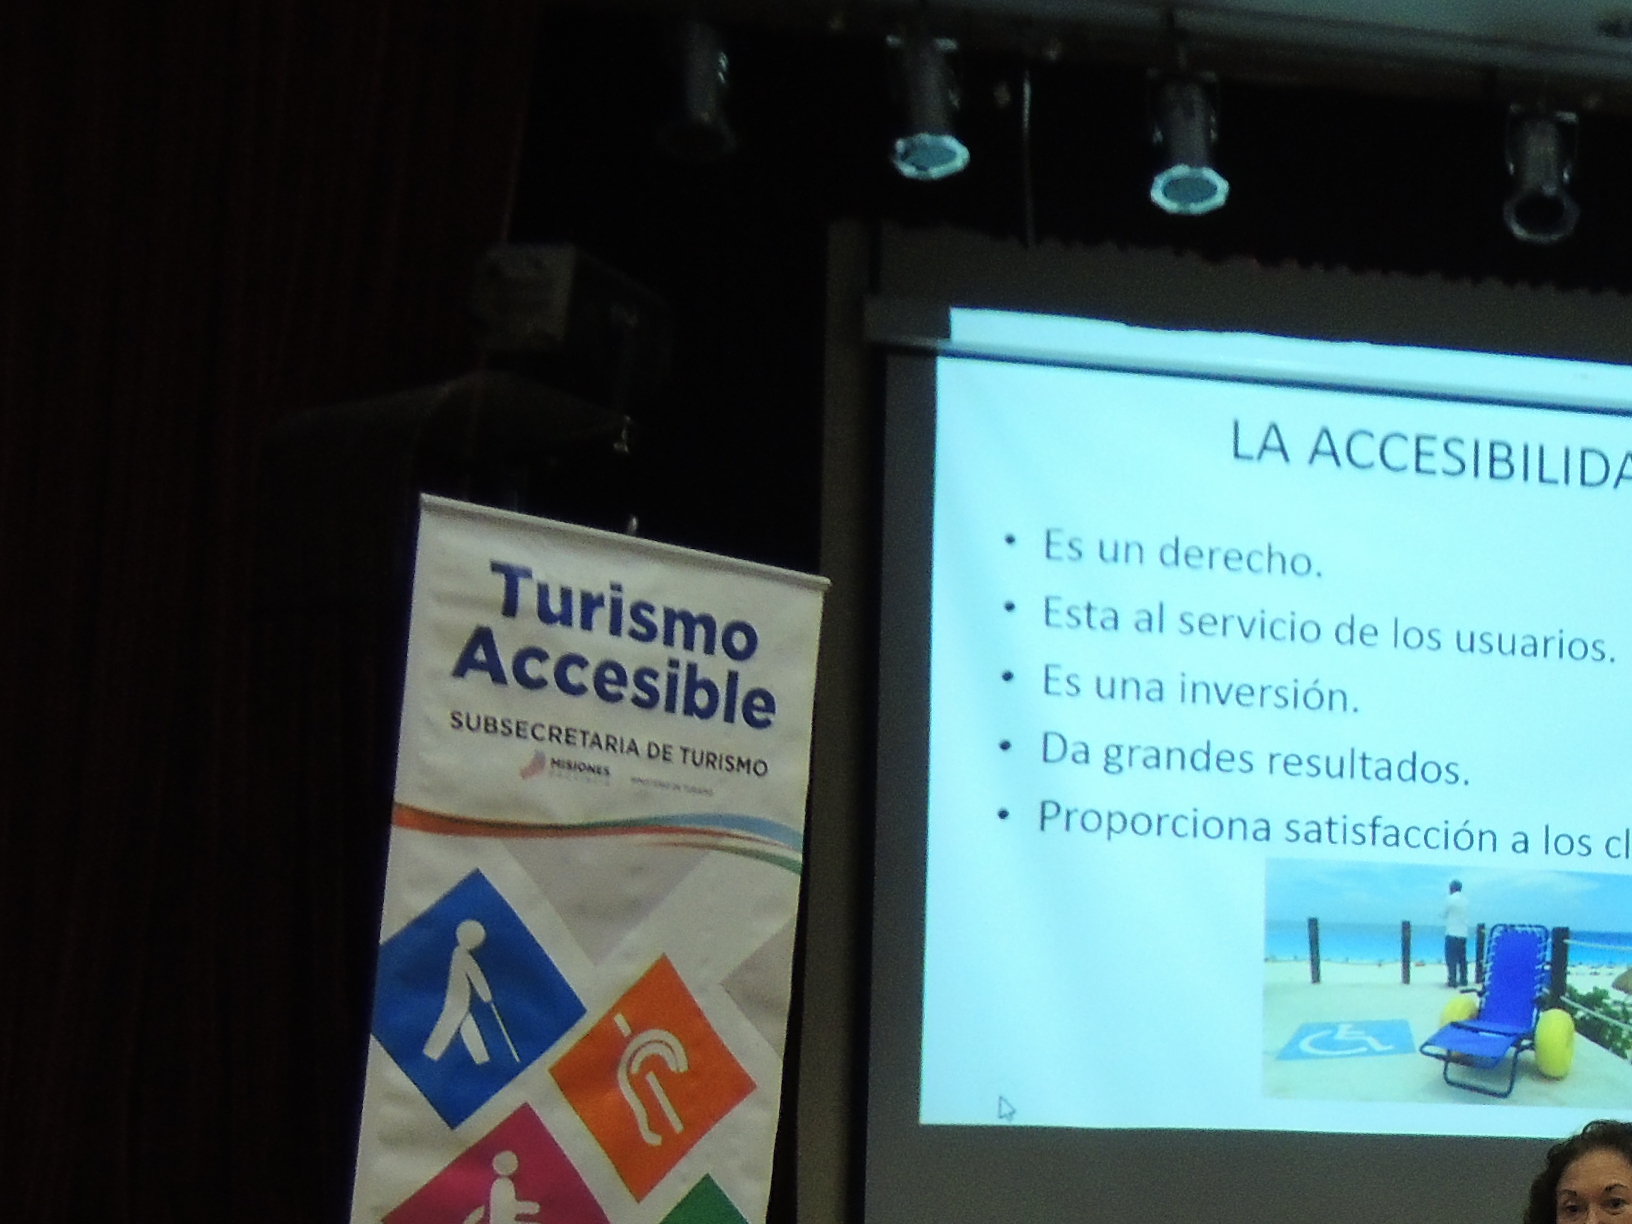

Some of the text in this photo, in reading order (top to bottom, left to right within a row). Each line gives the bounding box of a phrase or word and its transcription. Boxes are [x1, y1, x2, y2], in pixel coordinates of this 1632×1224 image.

[1232, 417, 1291, 465] LA
[1044, 527, 1323, 579] Es un derecho.
[489, 559, 759, 662] Turismo
[1044, 595, 1616, 664] Esta al servicio de los usuarios.
[451, 624, 777, 730] Accesible
[1043, 663, 1359, 714] Es una inversión.
[450, 710, 769, 778] SUBSECRETARIA DE TURISMO
[551, 757, 611, 776] MISIONES
[1041, 730, 1470, 787] Da grandes resultados.
[1038, 799, 1272, 843] Proporciona
[1284, 814, 1498, 853] satisfacción
[1510, 830, 1530, 855] a
[1544, 823, 1593, 858] los
